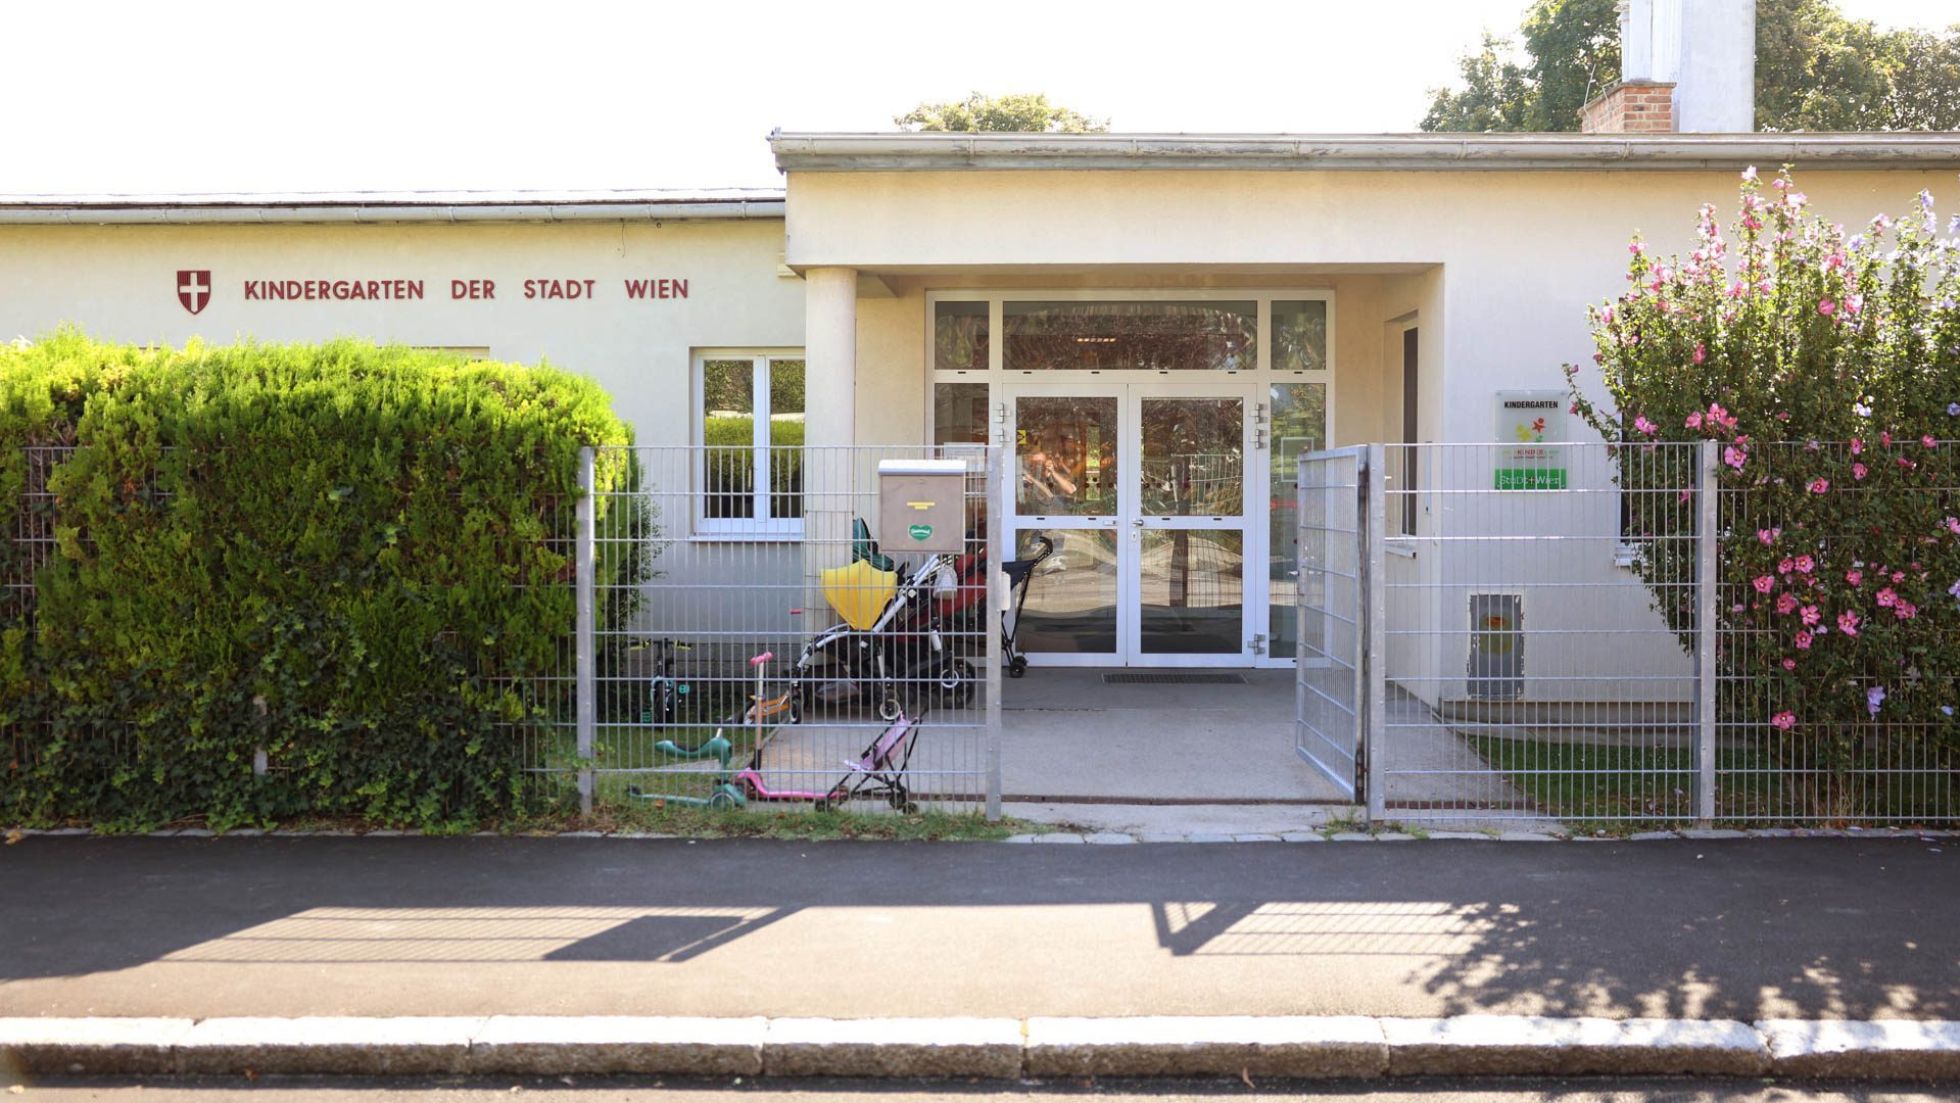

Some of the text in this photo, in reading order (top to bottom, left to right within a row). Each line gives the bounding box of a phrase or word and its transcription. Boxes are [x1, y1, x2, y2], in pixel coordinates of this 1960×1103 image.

[243, 278, 688, 300] KINDERGARTEN DER STADT WIEN
[1504, 400, 1558, 409] KINDERGARTEN
